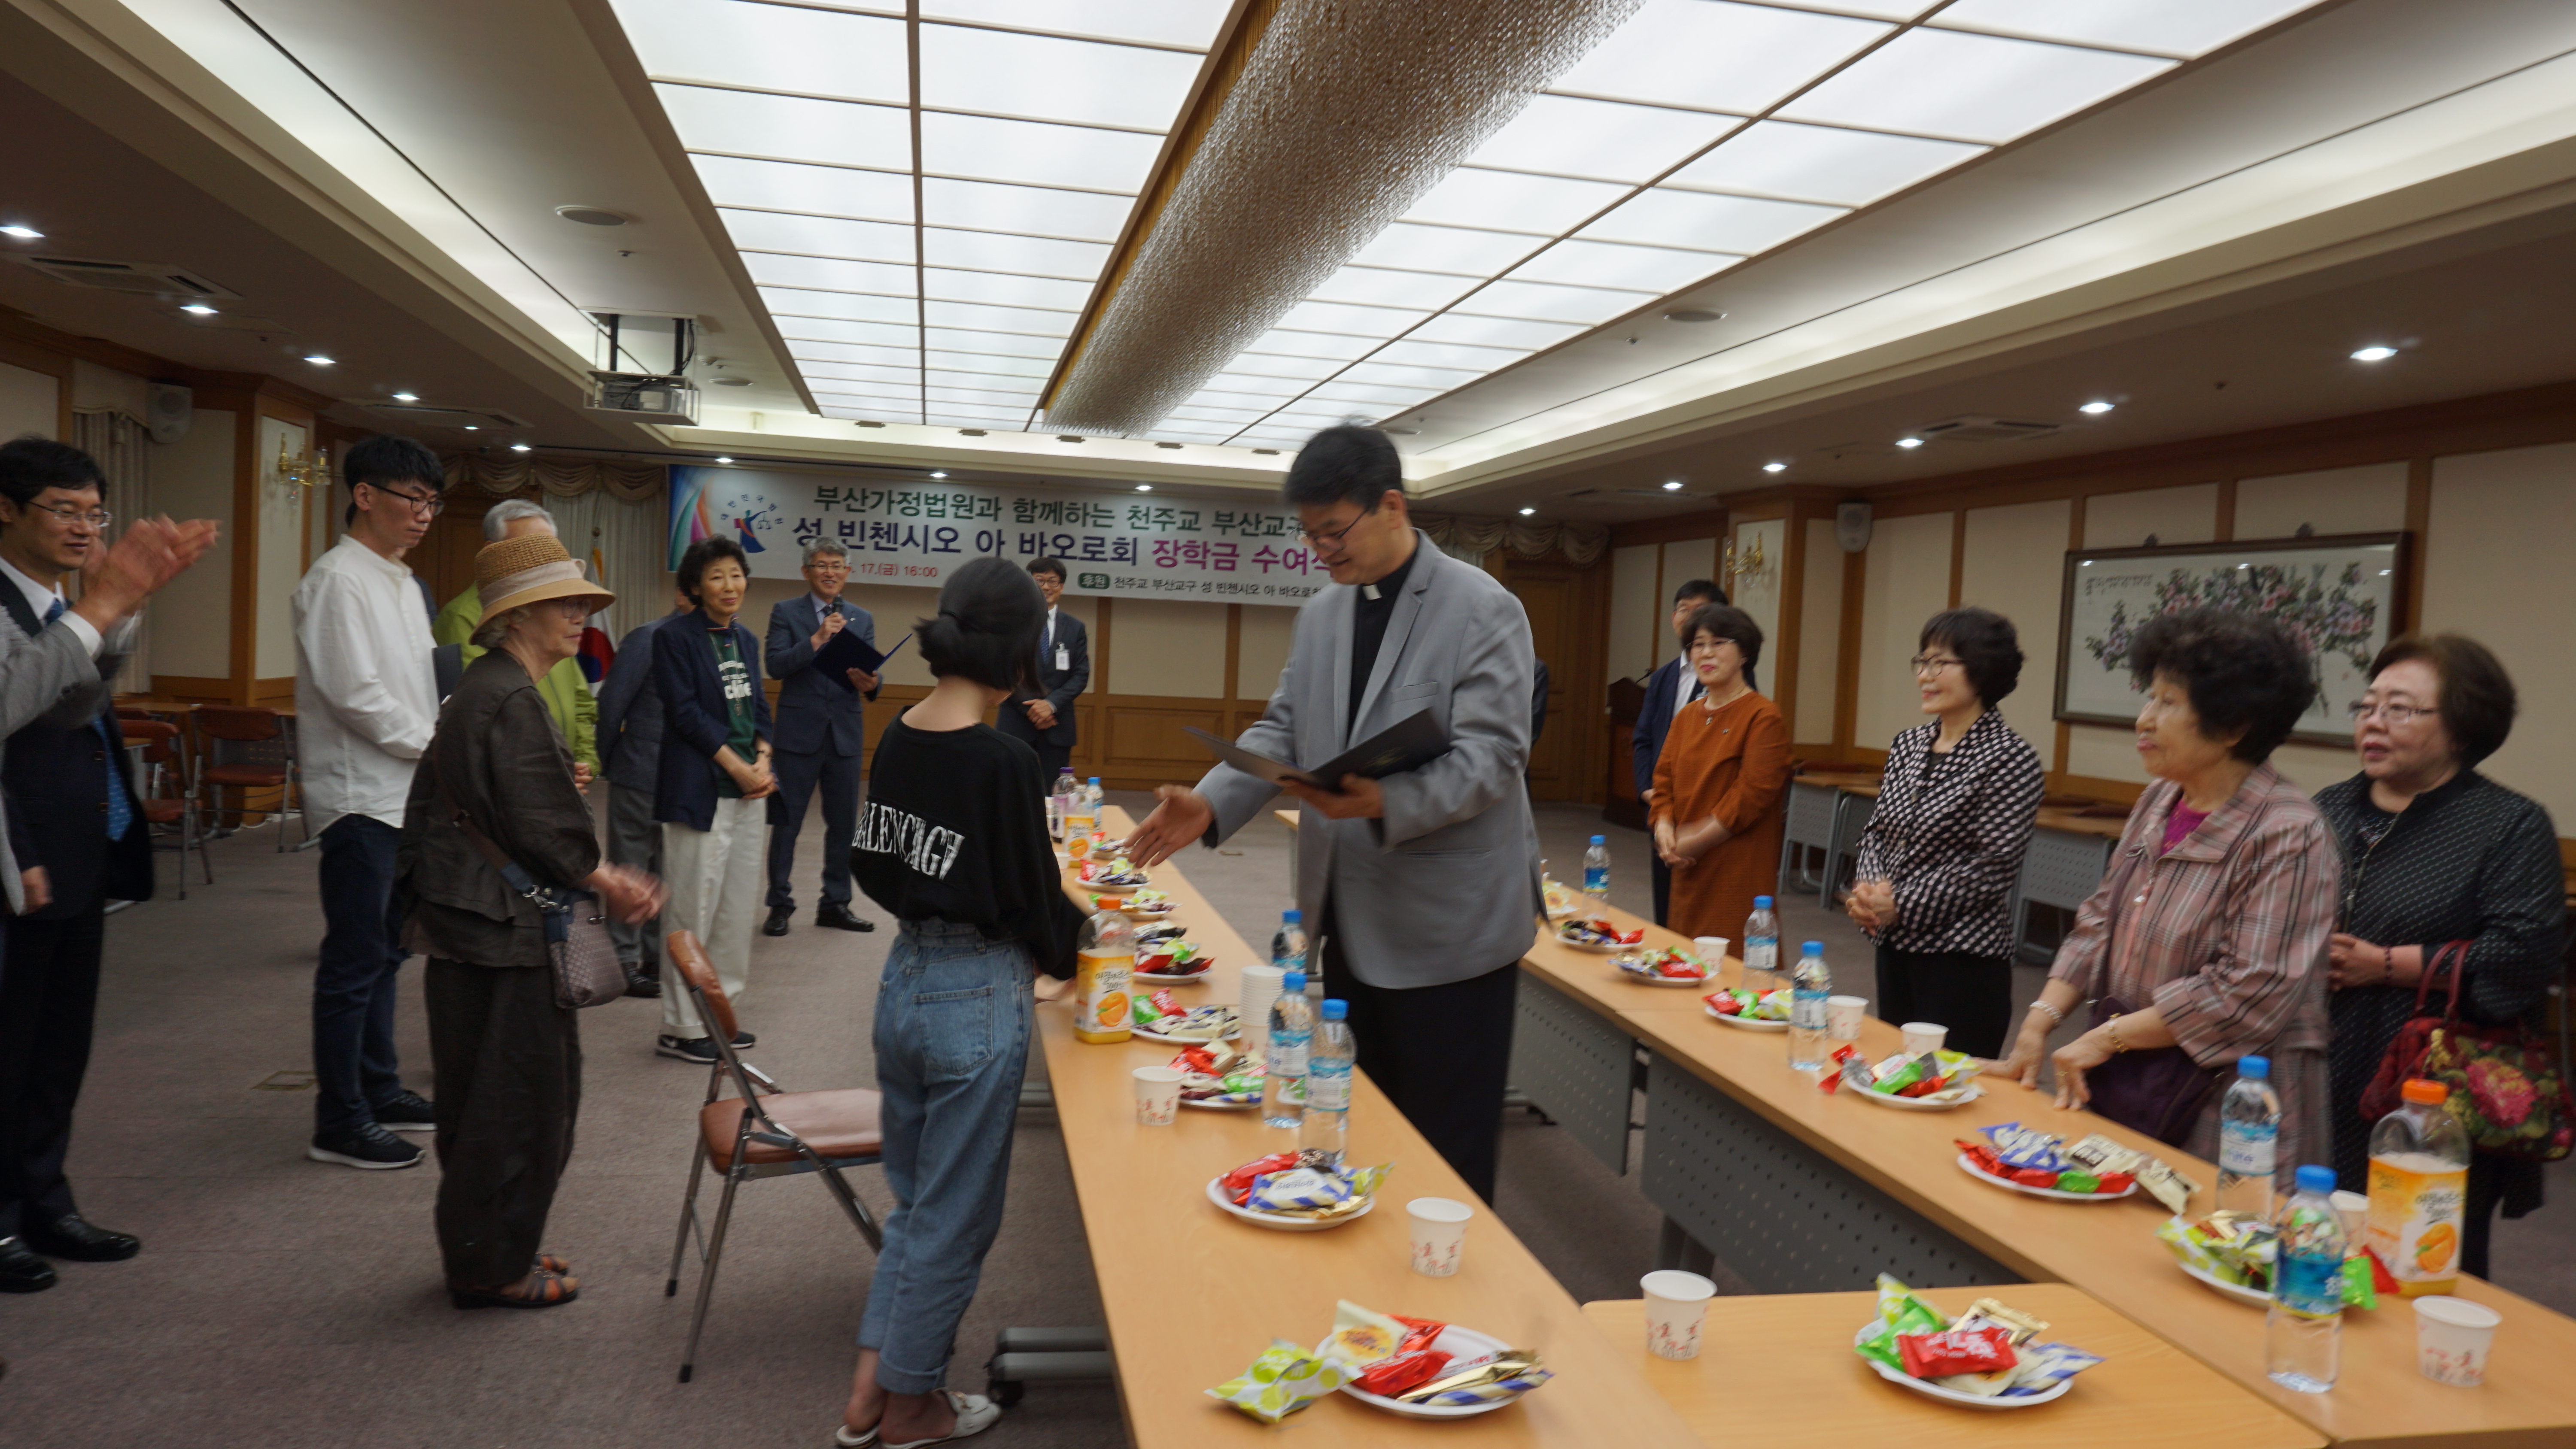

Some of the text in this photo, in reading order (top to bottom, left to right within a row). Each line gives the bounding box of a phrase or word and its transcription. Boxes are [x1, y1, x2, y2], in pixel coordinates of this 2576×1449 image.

[814, 485, 1003, 522] 부산가정법원과
[1012, 497, 1115, 528] 함께하는
[1127, 505, 1202, 533] 천주교
[838, 520, 962, 554] 빈첸시오
[975, 528, 1005, 558] 아
[1019, 530, 1138, 566] 바오로회
[1151, 539, 1240, 572] 장학금
[904, 566, 938, 577] 16:00
[1081, 574, 1106, 588] 후원
[1114, 576, 1148, 589] 천주교
[1151, 579, 1197, 592] 부산교구
[1201, 581, 1212, 593] 성
[1216, 582, 1261, 595] 빈첸시오
[1264, 585, 1276, 597] 아
